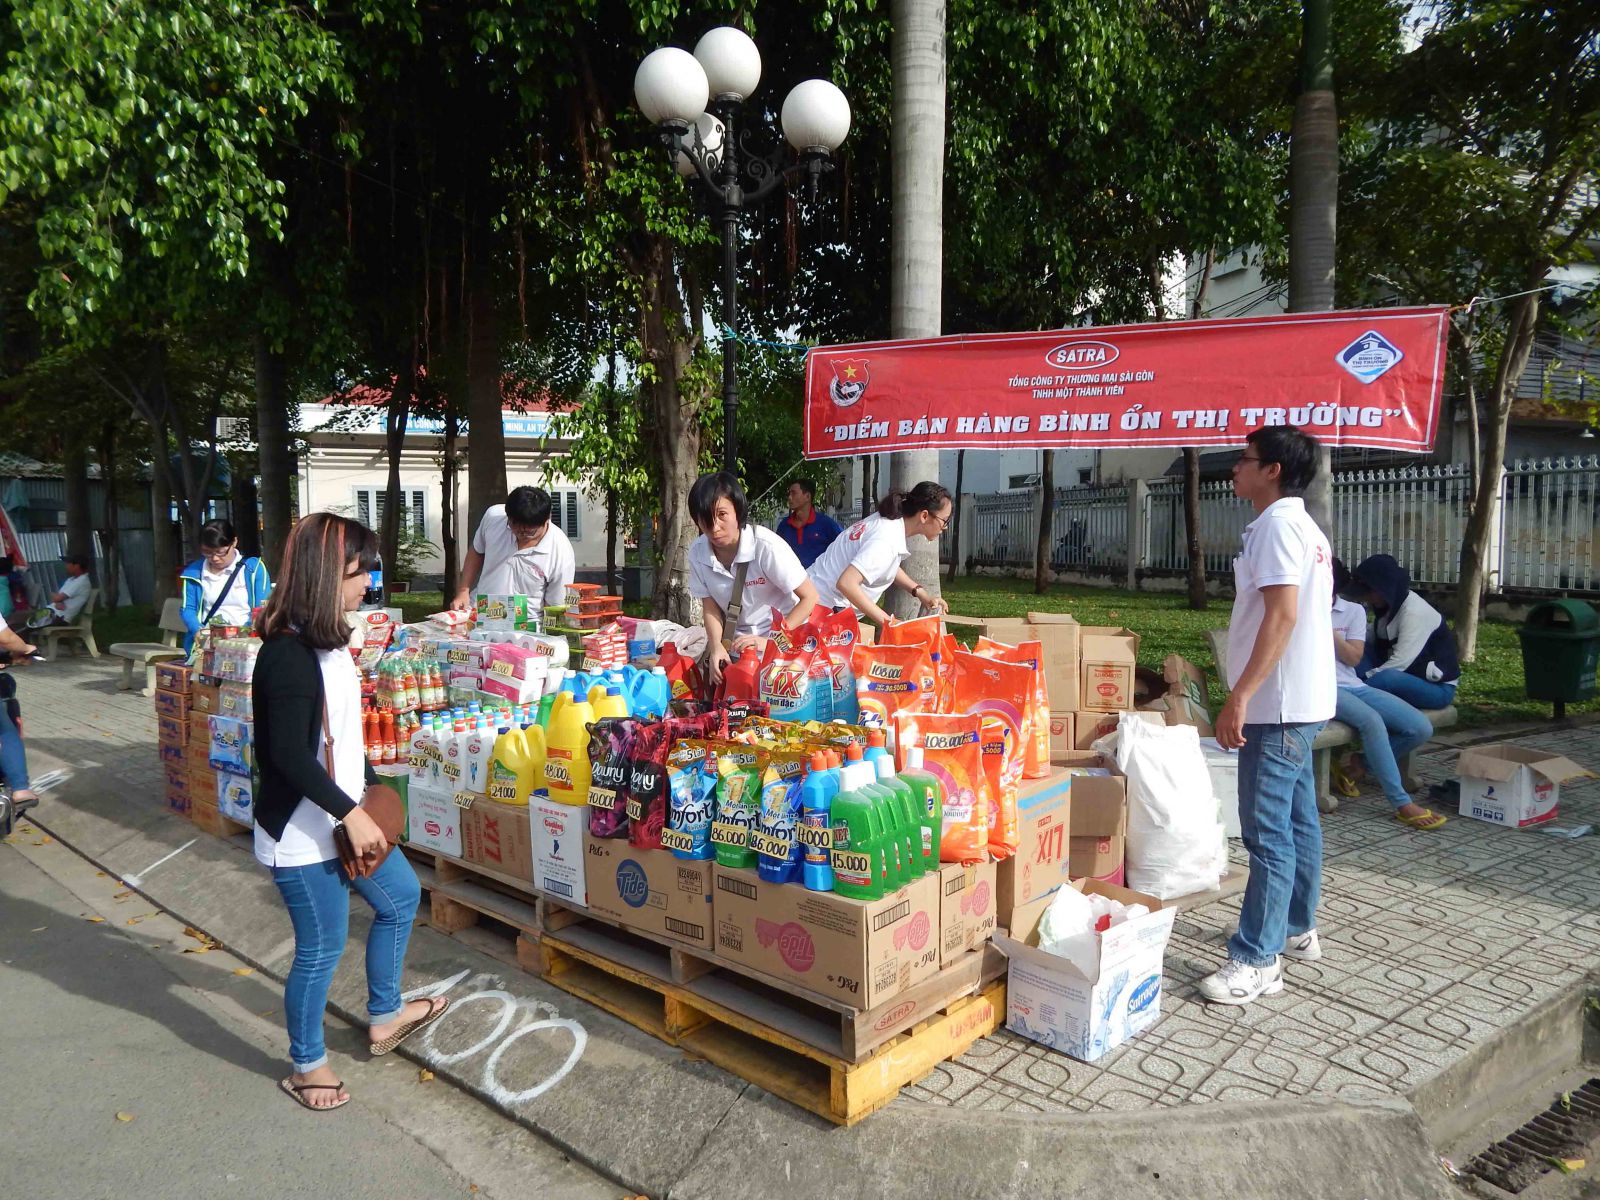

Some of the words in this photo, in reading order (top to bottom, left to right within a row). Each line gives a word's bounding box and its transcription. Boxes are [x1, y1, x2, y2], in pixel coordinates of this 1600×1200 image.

[1056, 348, 1106, 363] SATRA
[1008, 374, 1029, 387] TỔNG
[1030, 373, 1053, 386] CÔNG
[1055, 375, 1065, 385] TY
[1067, 373, 1100, 384] THƯƠNG
[1102, 372, 1118, 385] MẠI
[1119, 369, 1133, 381] SÀI
[1135, 369, 1154, 381] GÒN
[1032, 388, 1054, 399] TNHH
[1055, 386, 1073, 399] MỘT
[1075, 384, 1102, 397] THÀNH
[1105, 385, 1124, 396] VIÊN
[897, 414, 949, 436] BÁN
[955, 411, 1030, 434] HÀNG
[1038, 410, 1110, 433] BÌNH
[1120, 404, 1162, 431] ỔN
[1172, 408, 1229, 432] THỊ
[671, 802, 713, 830] mfort
[718, 810, 761, 830] mfort
[712, 827, 746, 845] 86.000
[751, 834, 787, 856] 86.000
[589, 844, 603, 857] P&G
[617, 871, 646, 898] Tide
[780, 933, 815, 962] Tide
[838, 976, 859, 994] P&G
[880, 1005, 910, 1027] SATRA
